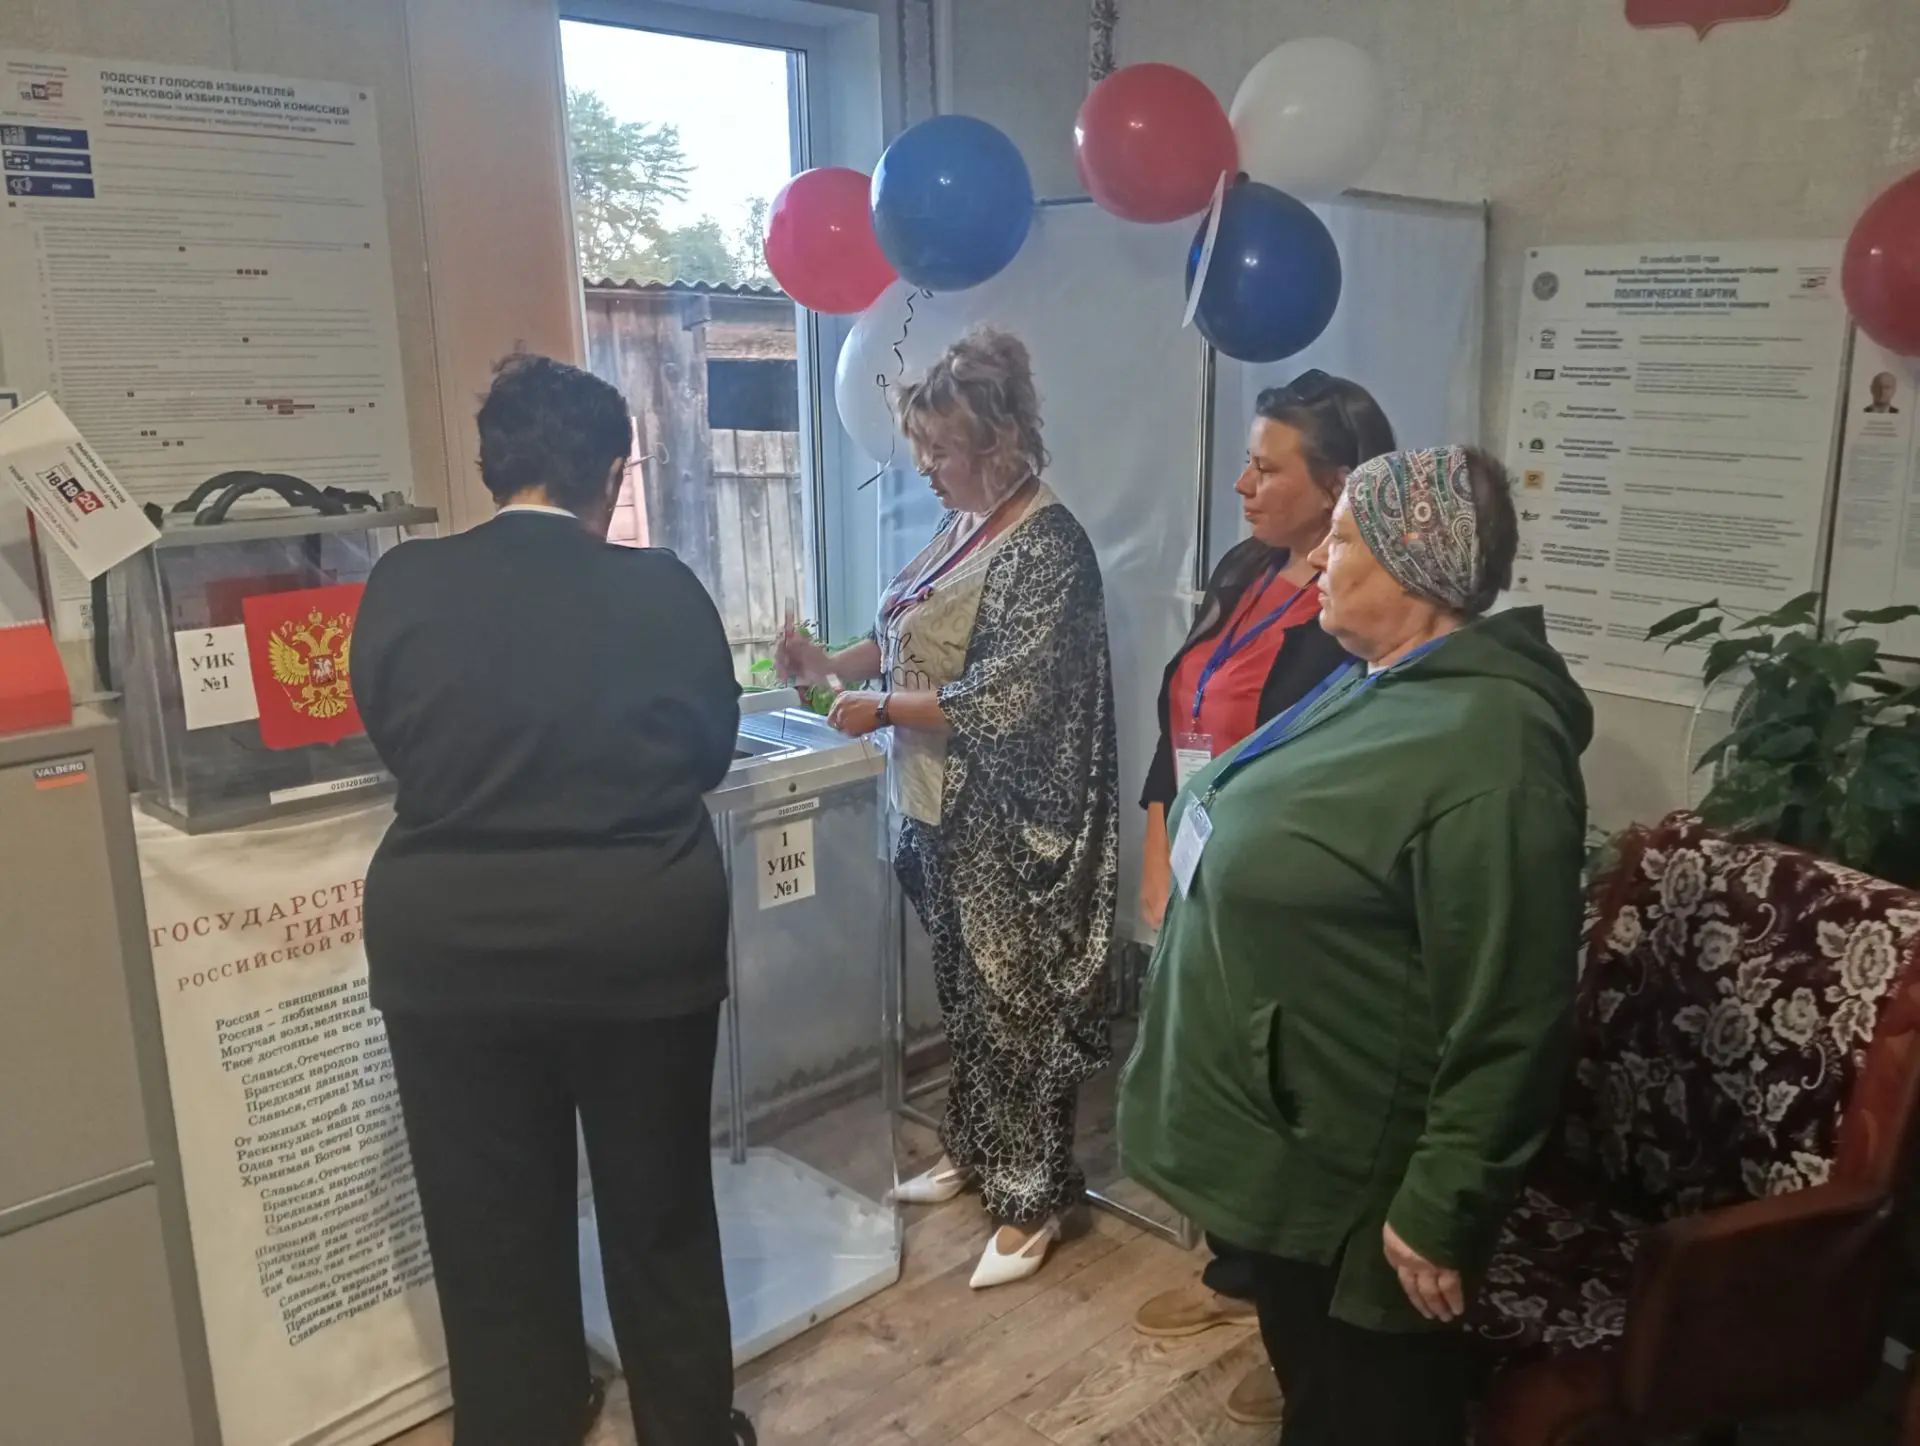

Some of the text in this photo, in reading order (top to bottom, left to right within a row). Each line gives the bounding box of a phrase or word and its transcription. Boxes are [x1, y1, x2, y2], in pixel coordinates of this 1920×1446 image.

[100, 71, 295, 98] ПОДСЧЕТ ГОЛОСОВ ИЗБИРАТЕЛЕЙ
[103, 85, 350, 115] УЧАСТКОВОЙ ИЗБИРАТЕЛЬНОЙ КОМИССИЕЙ
[1614, 288, 1693, 300] ПОЛИТИЧЕСКИЕ
[45, 470, 62, 487] 18
[62, 479, 79, 497] 19
[77, 492, 97, 511] 20
[204, 632, 214, 647] 2
[191, 652, 235, 671] УИК
[200, 675, 229, 692] №1
[36, 762, 85, 778] VALBERG
[782, 831, 788, 847] 1
[768, 851, 806, 876] УИК
[773, 878, 800, 899] №1
[178, 936, 332, 992] РОССИЙСКОЙ
[215, 1010, 260, 1031] Россия
[278, 983, 347, 1010] священная
[352, 977, 367, 988] на
[218, 1024, 263, 1045] Россия
[281, 1000, 337, 1024] любимая
[221, 1034, 276, 1059] Могучая
[258, 1034, 319, 1063] достоянье
[323, 1029, 338, 1039] на
[342, 1021, 362, 1033] все
[367, 1016, 382, 1027] вр
[244, 1072, 305, 1099] Братских
[309, 1055, 358, 1078] народов
[246, 1084, 311, 1112] Предками
[316, 1068, 359, 1090] данная
[352, 1078, 375, 1090] Мы
[234, 1136, 252, 1147] От
[258, 1121, 307, 1141] южных
[312, 1102, 347, 1124] морей
[352, 1099, 366, 1111] до
[237, 1127, 323, 1161] Раскинулись
[327, 1114, 360, 1132] наши
[365, 1103, 391, 1118] леса
[239, 1159, 273, 1173] Одна
[278, 1152, 296, 1163] ты
[300, 1145, 315, 1156] на
[318, 1126, 353, 1149] свете!
[356, 1119, 386, 1134] Одна
[241, 1159, 310, 1187] Хранимая
[315, 1144, 351, 1164] Богом
[263, 1186, 324, 1211] Братских
[329, 1167, 377, 1190] народов
[264, 1196, 330, 1224] Предками
[335, 1179, 376, 1202] данная
[255, 1230, 317, 1259] Широкий
[321, 1212, 369, 1236] простор
[257, 1243, 320, 1272] Грядущее
[325, 1232, 348, 1247] нам
[260, 1268, 283, 1285] Нам
[291, 1255, 321, 1271] силу
[262, 1282, 282, 1298] Так
[282, 1289, 337, 1320] Братских
[342, 1268, 388, 1293] народов
[285, 1299, 342, 1334] Предками
[347, 1279, 388, 1304] данная
